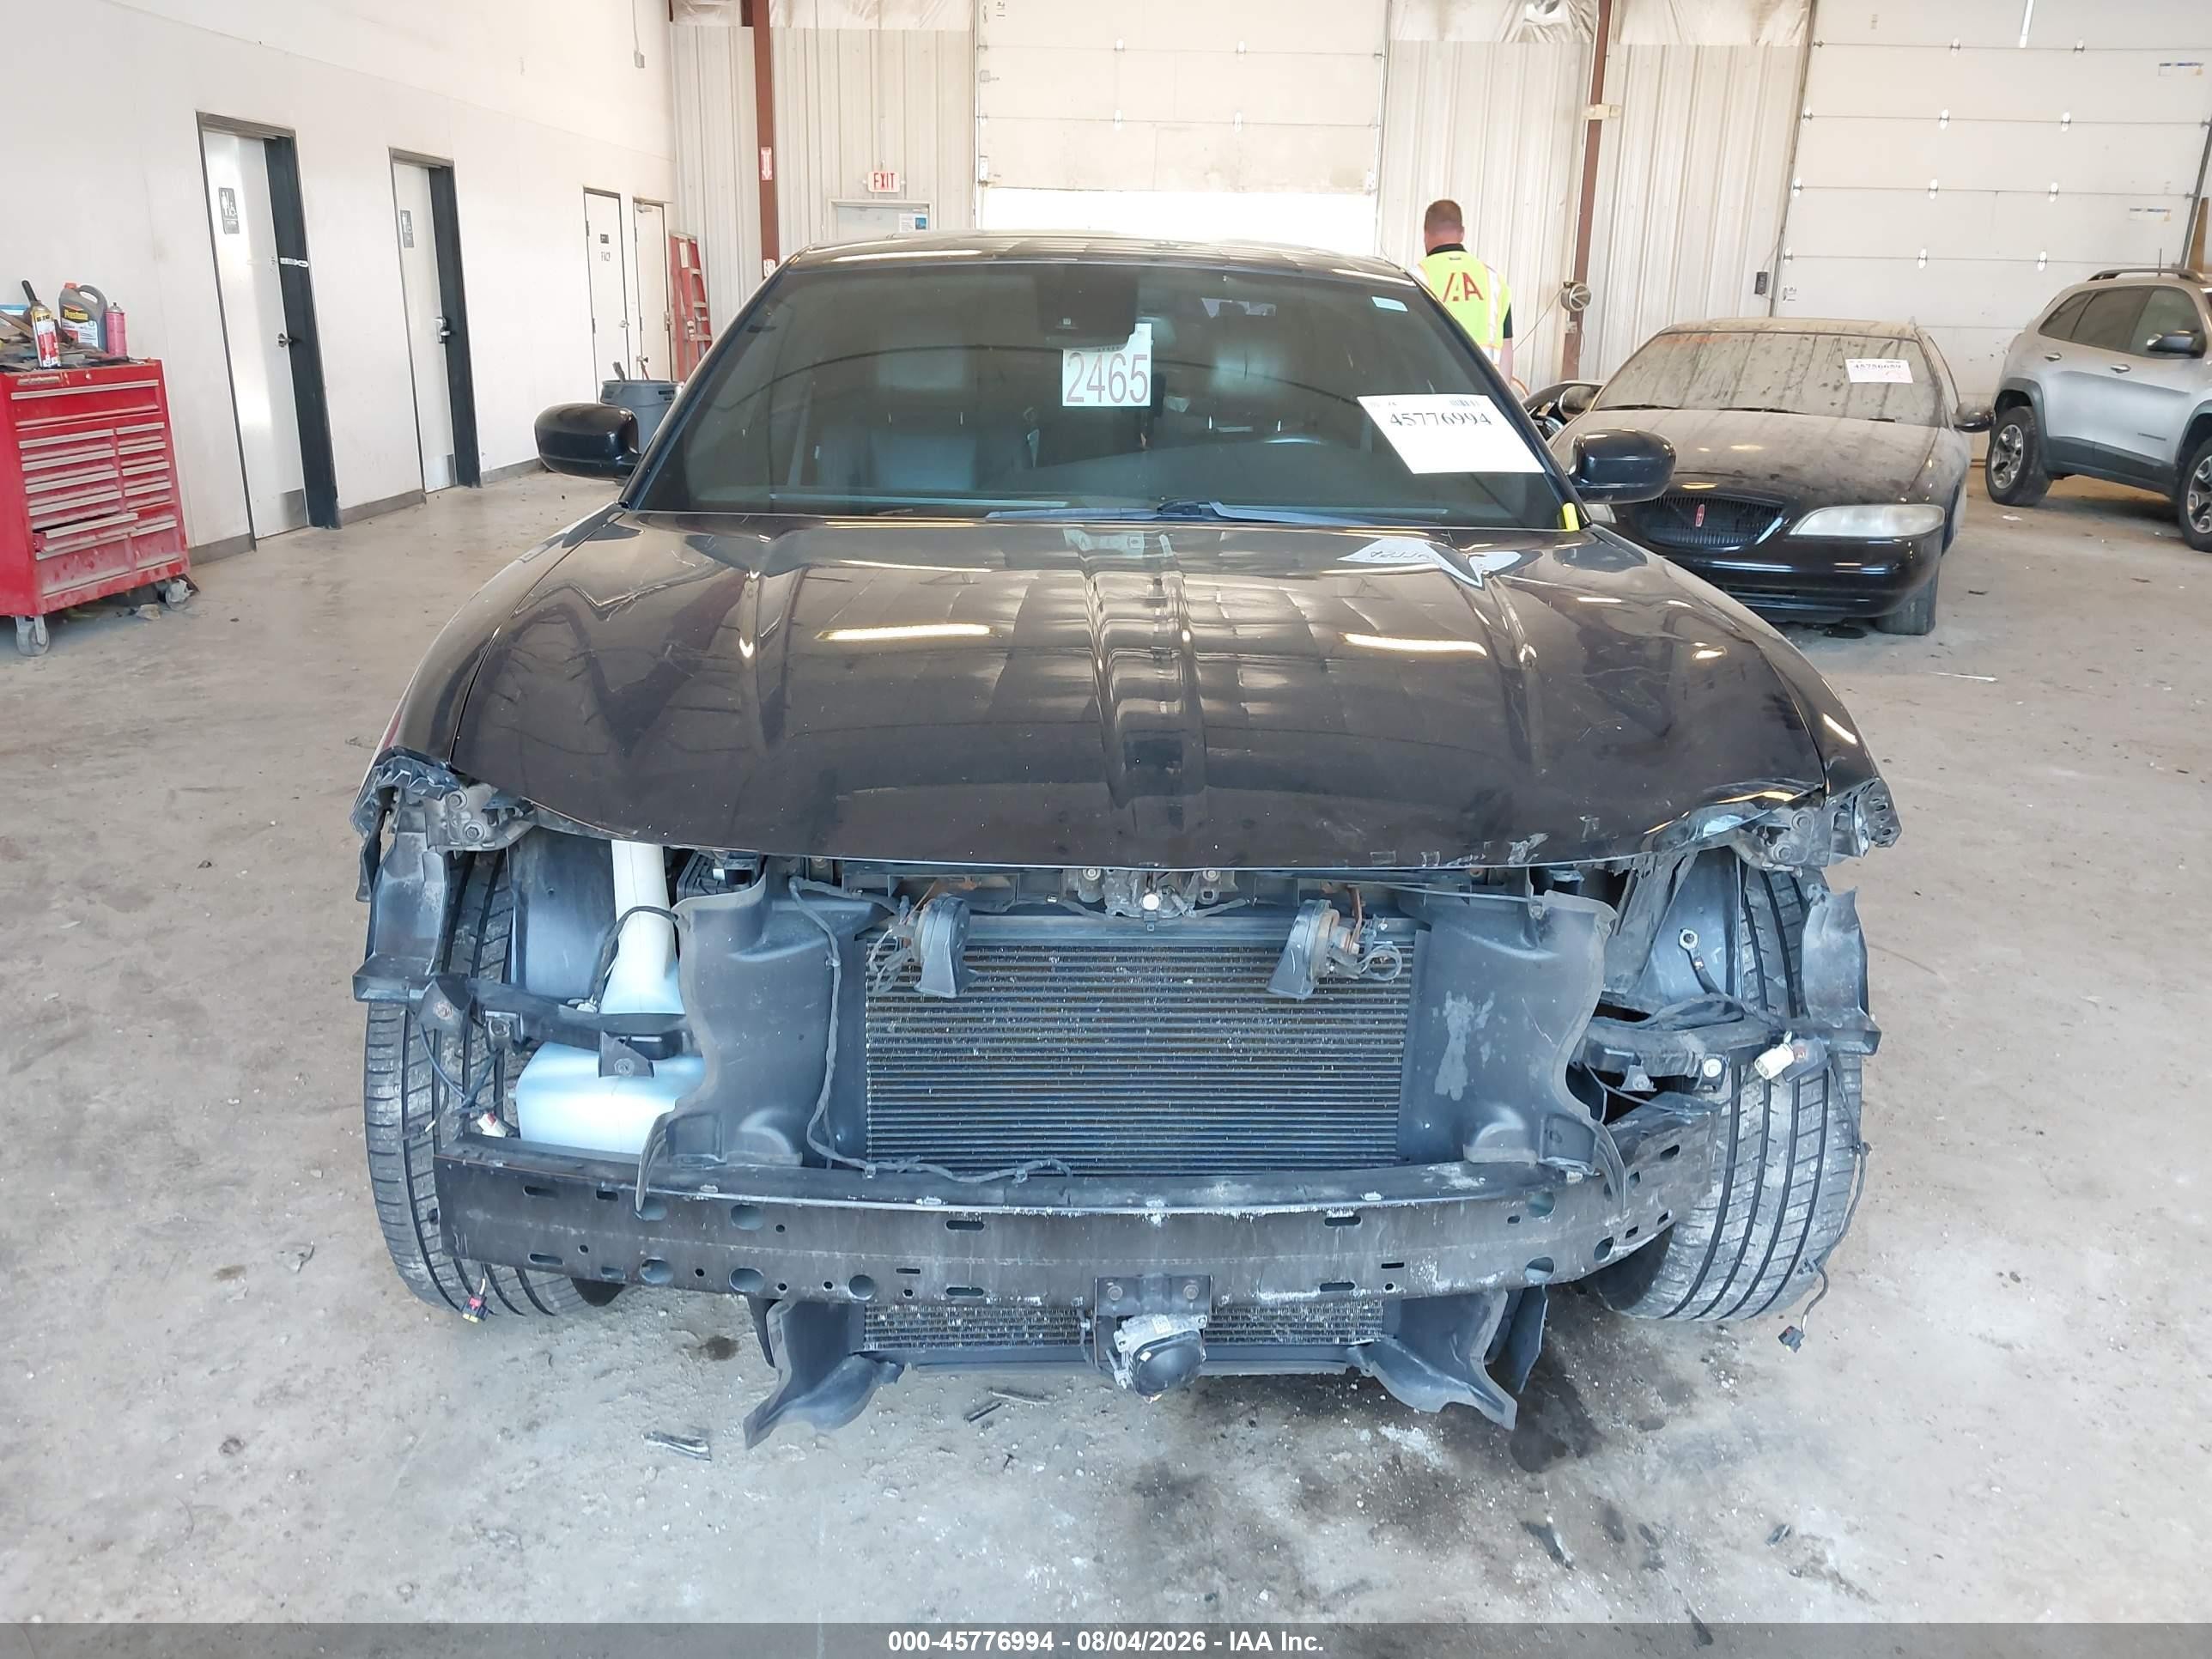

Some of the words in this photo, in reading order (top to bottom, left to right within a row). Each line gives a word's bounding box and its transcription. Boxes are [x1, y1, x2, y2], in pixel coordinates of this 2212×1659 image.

[873, 173, 895, 191] EXIT
[1066, 351, 1148, 404] 2465
[1389, 412, 1492, 427] 45776994
